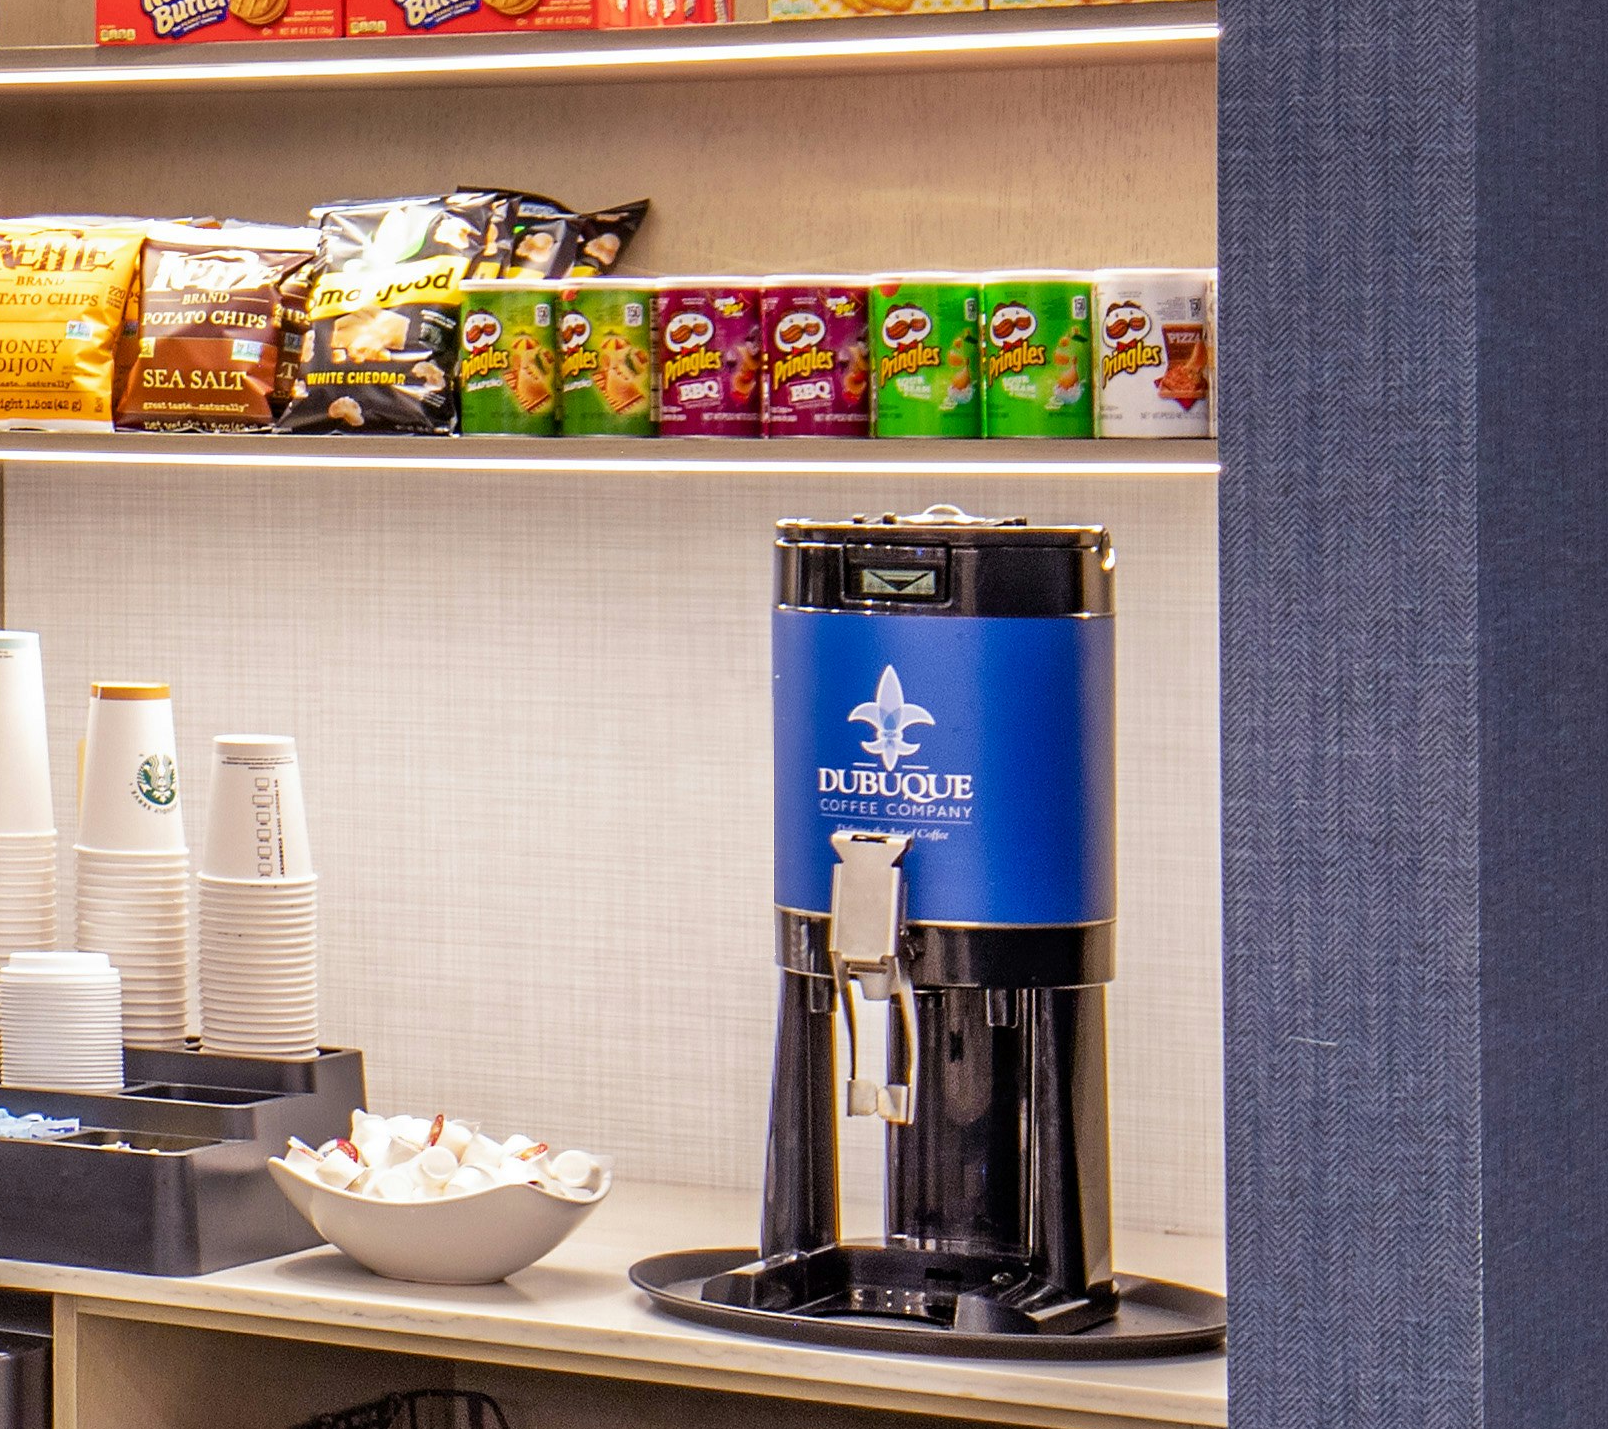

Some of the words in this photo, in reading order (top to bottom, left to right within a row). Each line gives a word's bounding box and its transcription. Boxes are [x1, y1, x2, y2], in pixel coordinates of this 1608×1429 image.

[15, 274, 65, 286] BRAND
[47, 294, 99, 307] CHIPS
[181, 291, 230, 305] BRAND
[142, 311, 205, 327] POTATO
[210, 309, 268, 329] CHIPS
[663, 349, 723, 389] Pringles
[773, 349, 835, 389] Pringles
[879, 343, 942, 389] Pringles
[142, 369, 187, 390] SEA
[190, 370, 246, 391] SALT
[306, 371, 344, 386] WHITE
[346, 371, 406, 385] CHEDDAR
[679, 381, 720, 403] BBQ
[789, 380, 831, 402] BBQ
[817, 768, 975, 803] DUBUQUE
[819, 797, 879, 816] COFFEE
[885, 801, 974, 820] COMPANY
